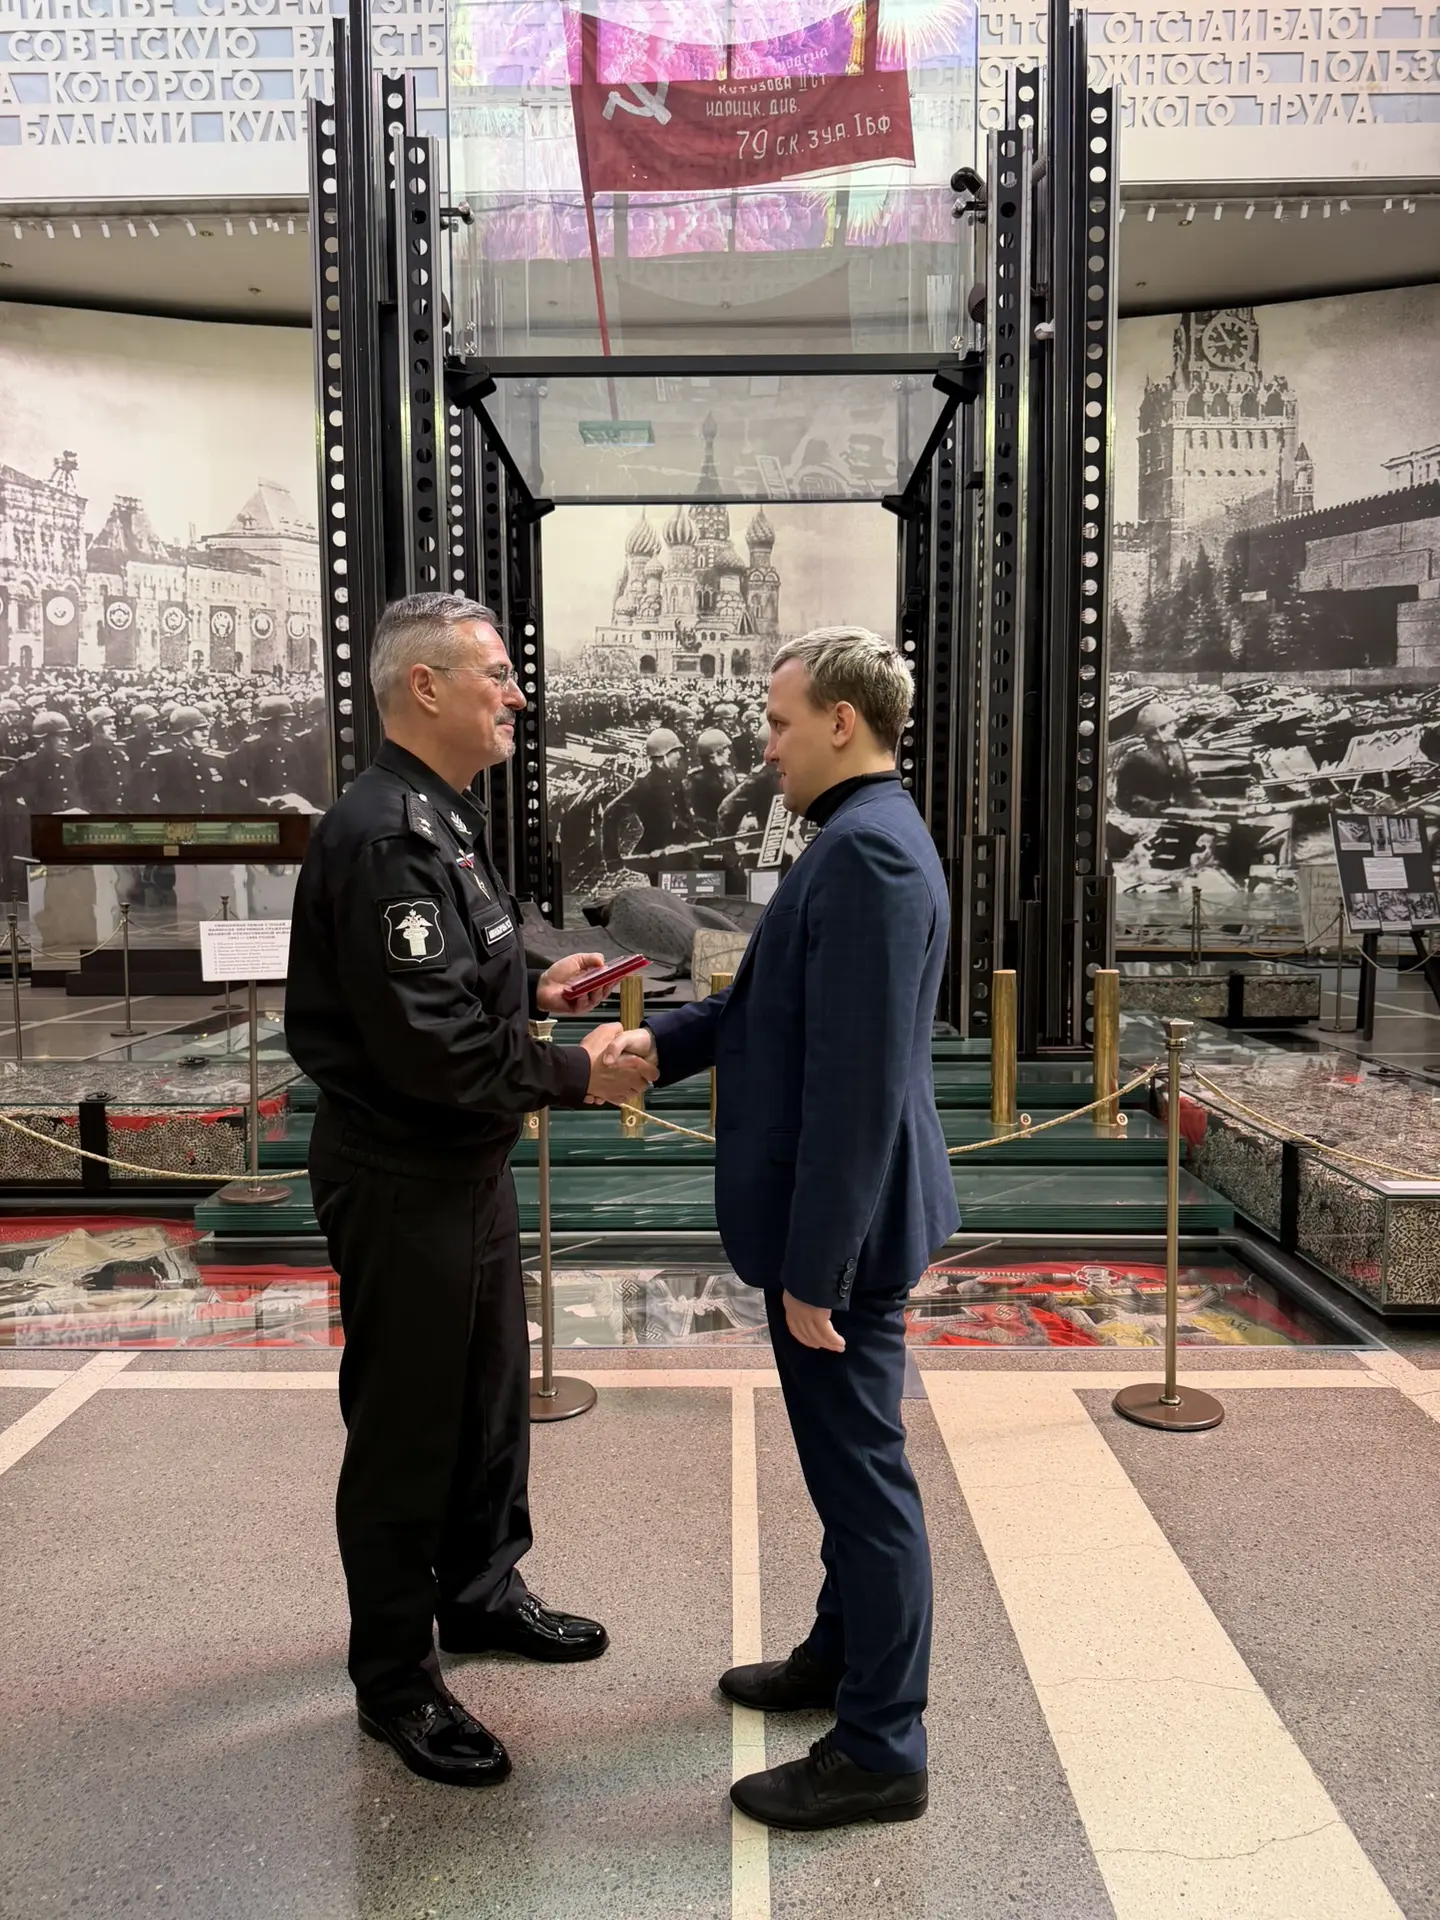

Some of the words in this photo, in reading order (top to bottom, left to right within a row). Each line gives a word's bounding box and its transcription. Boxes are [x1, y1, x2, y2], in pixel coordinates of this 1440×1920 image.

[1104, 8, 1384, 44] ОТСТАИВАЮТ
[1413, 7, 1440, 40] Т
[8, 28, 257, 62] СОВЕТСКУЮ
[295, 24, 445, 59] ВЛСТЬ
[1301, 49, 1440, 82] ПОЛЬЗ
[48, 69, 262, 103] КОТОРОГО
[1256, 92, 1385, 126] ТРУДА.
[20, 111, 192, 146] БЛАГАМИ
[736, 128, 769, 160] 79
